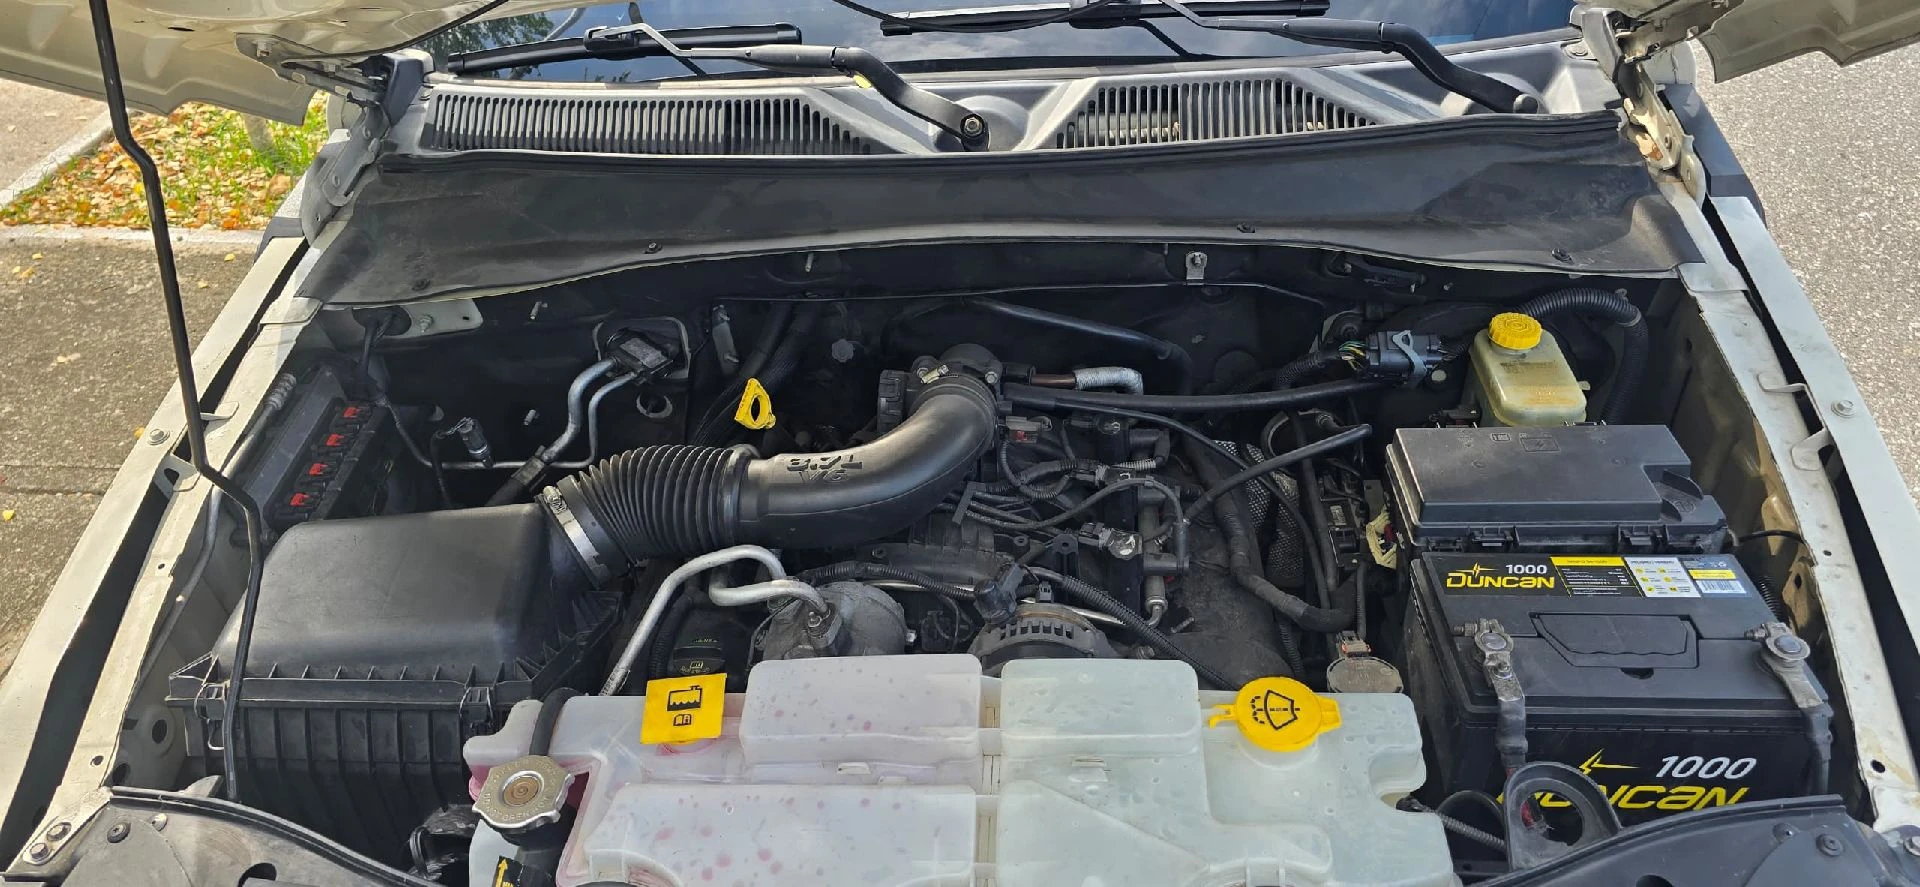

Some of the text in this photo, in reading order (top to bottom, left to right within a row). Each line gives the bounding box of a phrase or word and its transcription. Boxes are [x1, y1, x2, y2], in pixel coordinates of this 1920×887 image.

[788, 455, 863, 471] 3.7L
[1506, 563, 1548, 575] 1000
[1656, 755, 1758, 779] 1000
